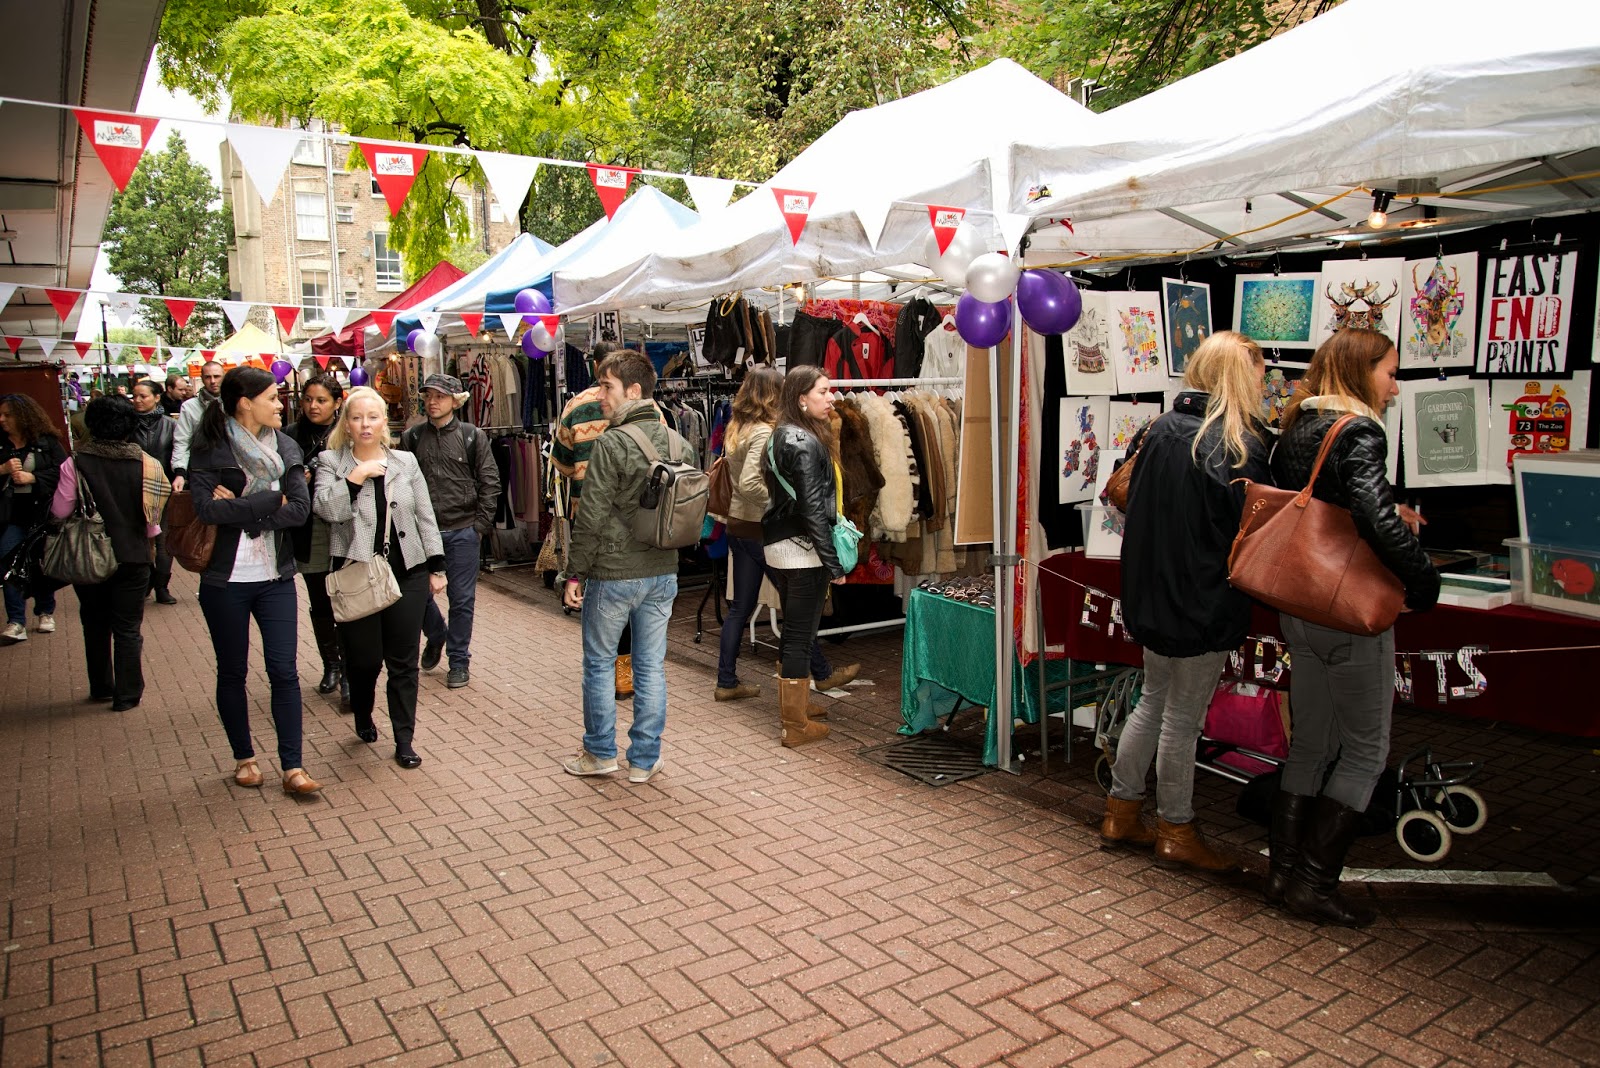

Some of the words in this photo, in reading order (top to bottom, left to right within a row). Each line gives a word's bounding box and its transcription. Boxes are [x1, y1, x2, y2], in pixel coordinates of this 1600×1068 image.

[1491, 253, 1568, 297] EAST
[1488, 297, 1562, 340] END
[1141, 340, 1157, 352] TIRED
[1485, 340, 1559, 373] PRINTS
[1427, 402, 1463, 413] GARDENING
[1437, 413, 1459, 421] CHEAPER
[1519, 421, 1531, 431] 73
[1442, 446, 1464, 454] THERAPY
[1079, 585, 1135, 643] EA
